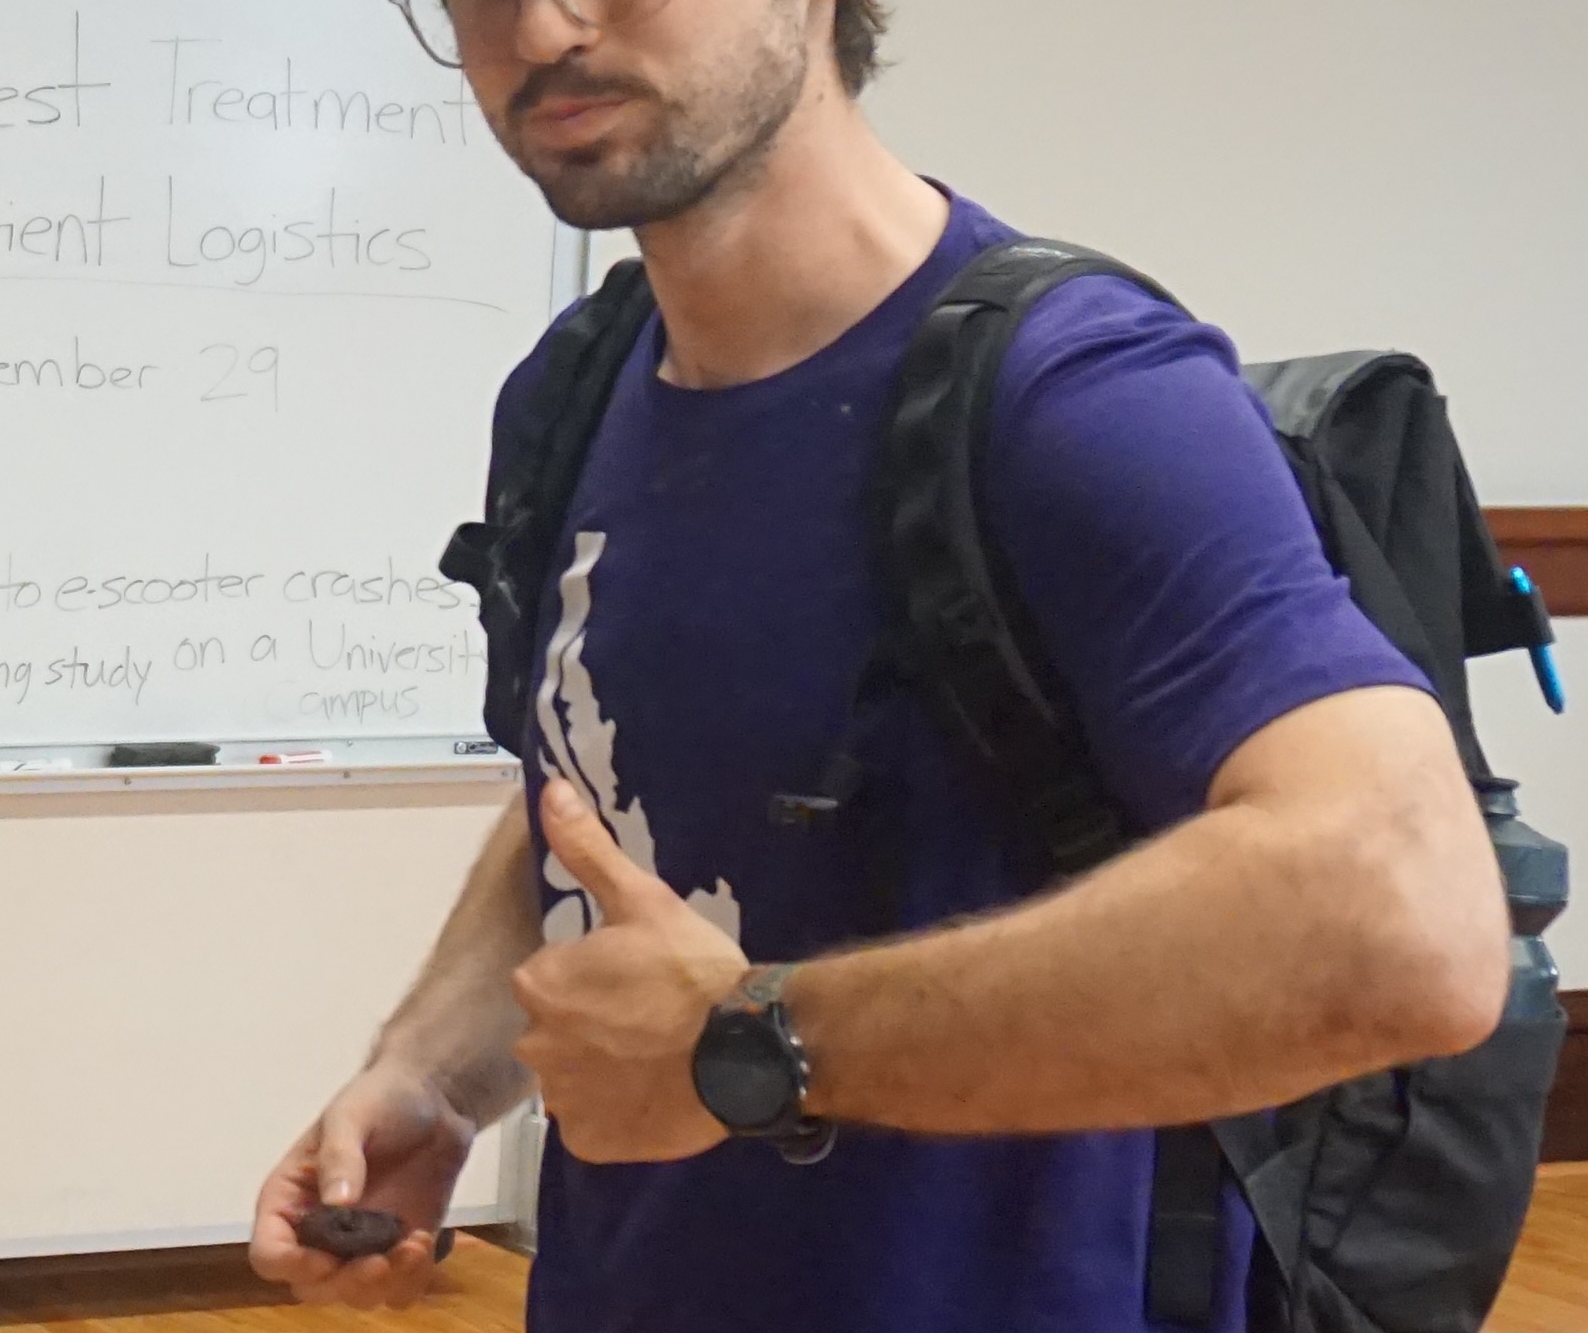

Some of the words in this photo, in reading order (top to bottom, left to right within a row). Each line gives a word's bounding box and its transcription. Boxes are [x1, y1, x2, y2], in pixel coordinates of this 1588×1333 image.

[149, 34, 480, 148] Treatment
[167, 175, 433, 286] Logistics
[199, 342, 282, 413] 29
[42, 645, 152, 706] study
[172, 633, 225, 673] on
[250, 633, 277, 663] a
